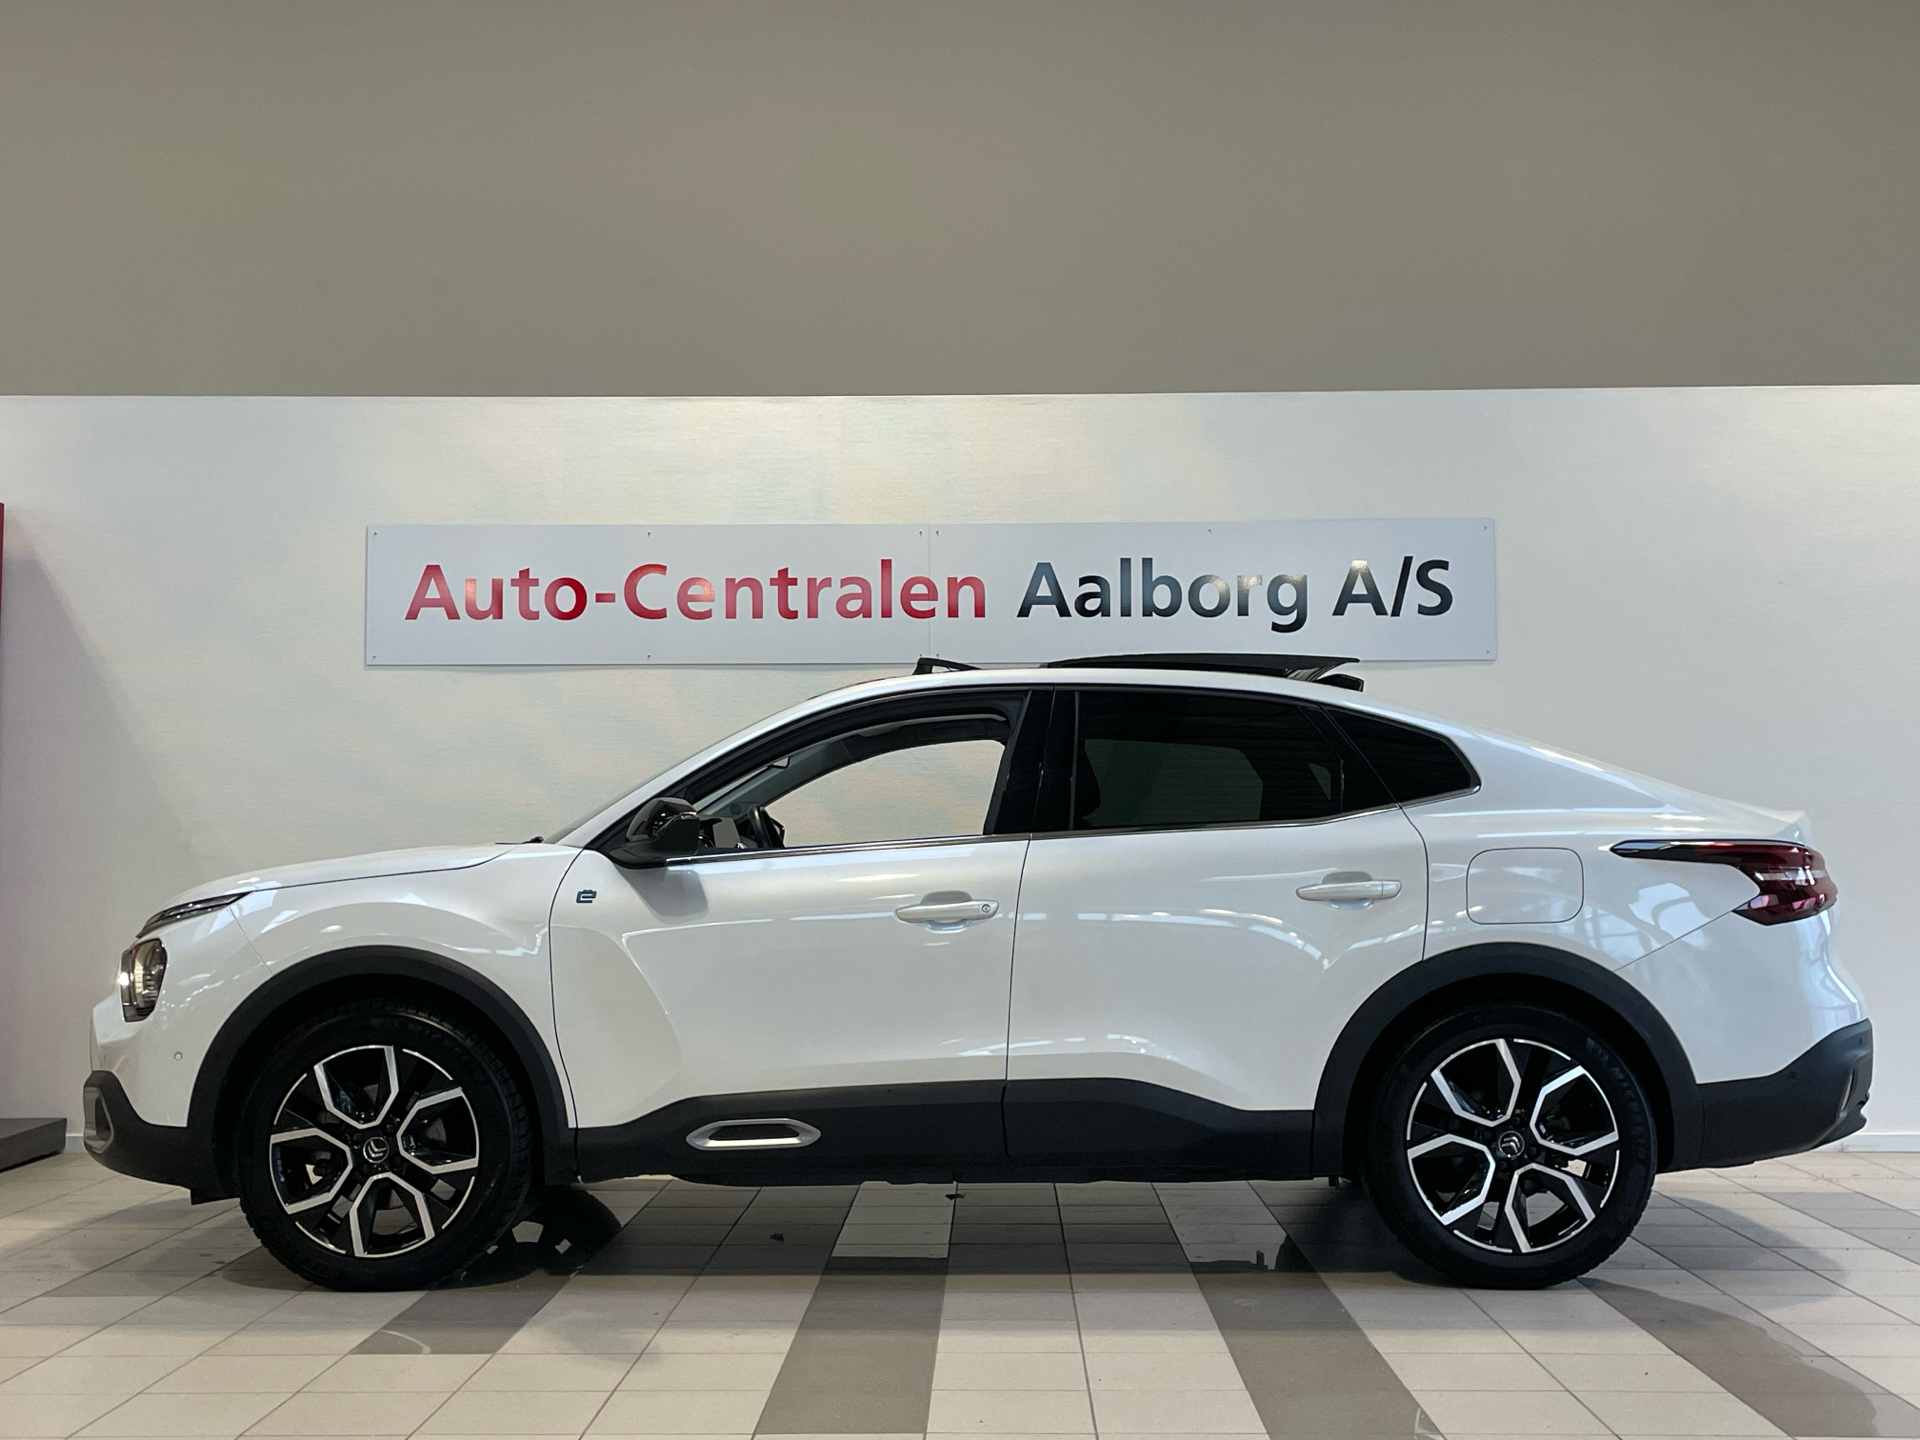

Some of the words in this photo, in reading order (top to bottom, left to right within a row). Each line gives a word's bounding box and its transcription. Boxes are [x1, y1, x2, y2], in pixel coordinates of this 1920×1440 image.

[404, 558, 986, 621] Auto-Centralen
[1016, 557, 1308, 634] Aalborg
[1331, 555, 1454, 618] A/S
